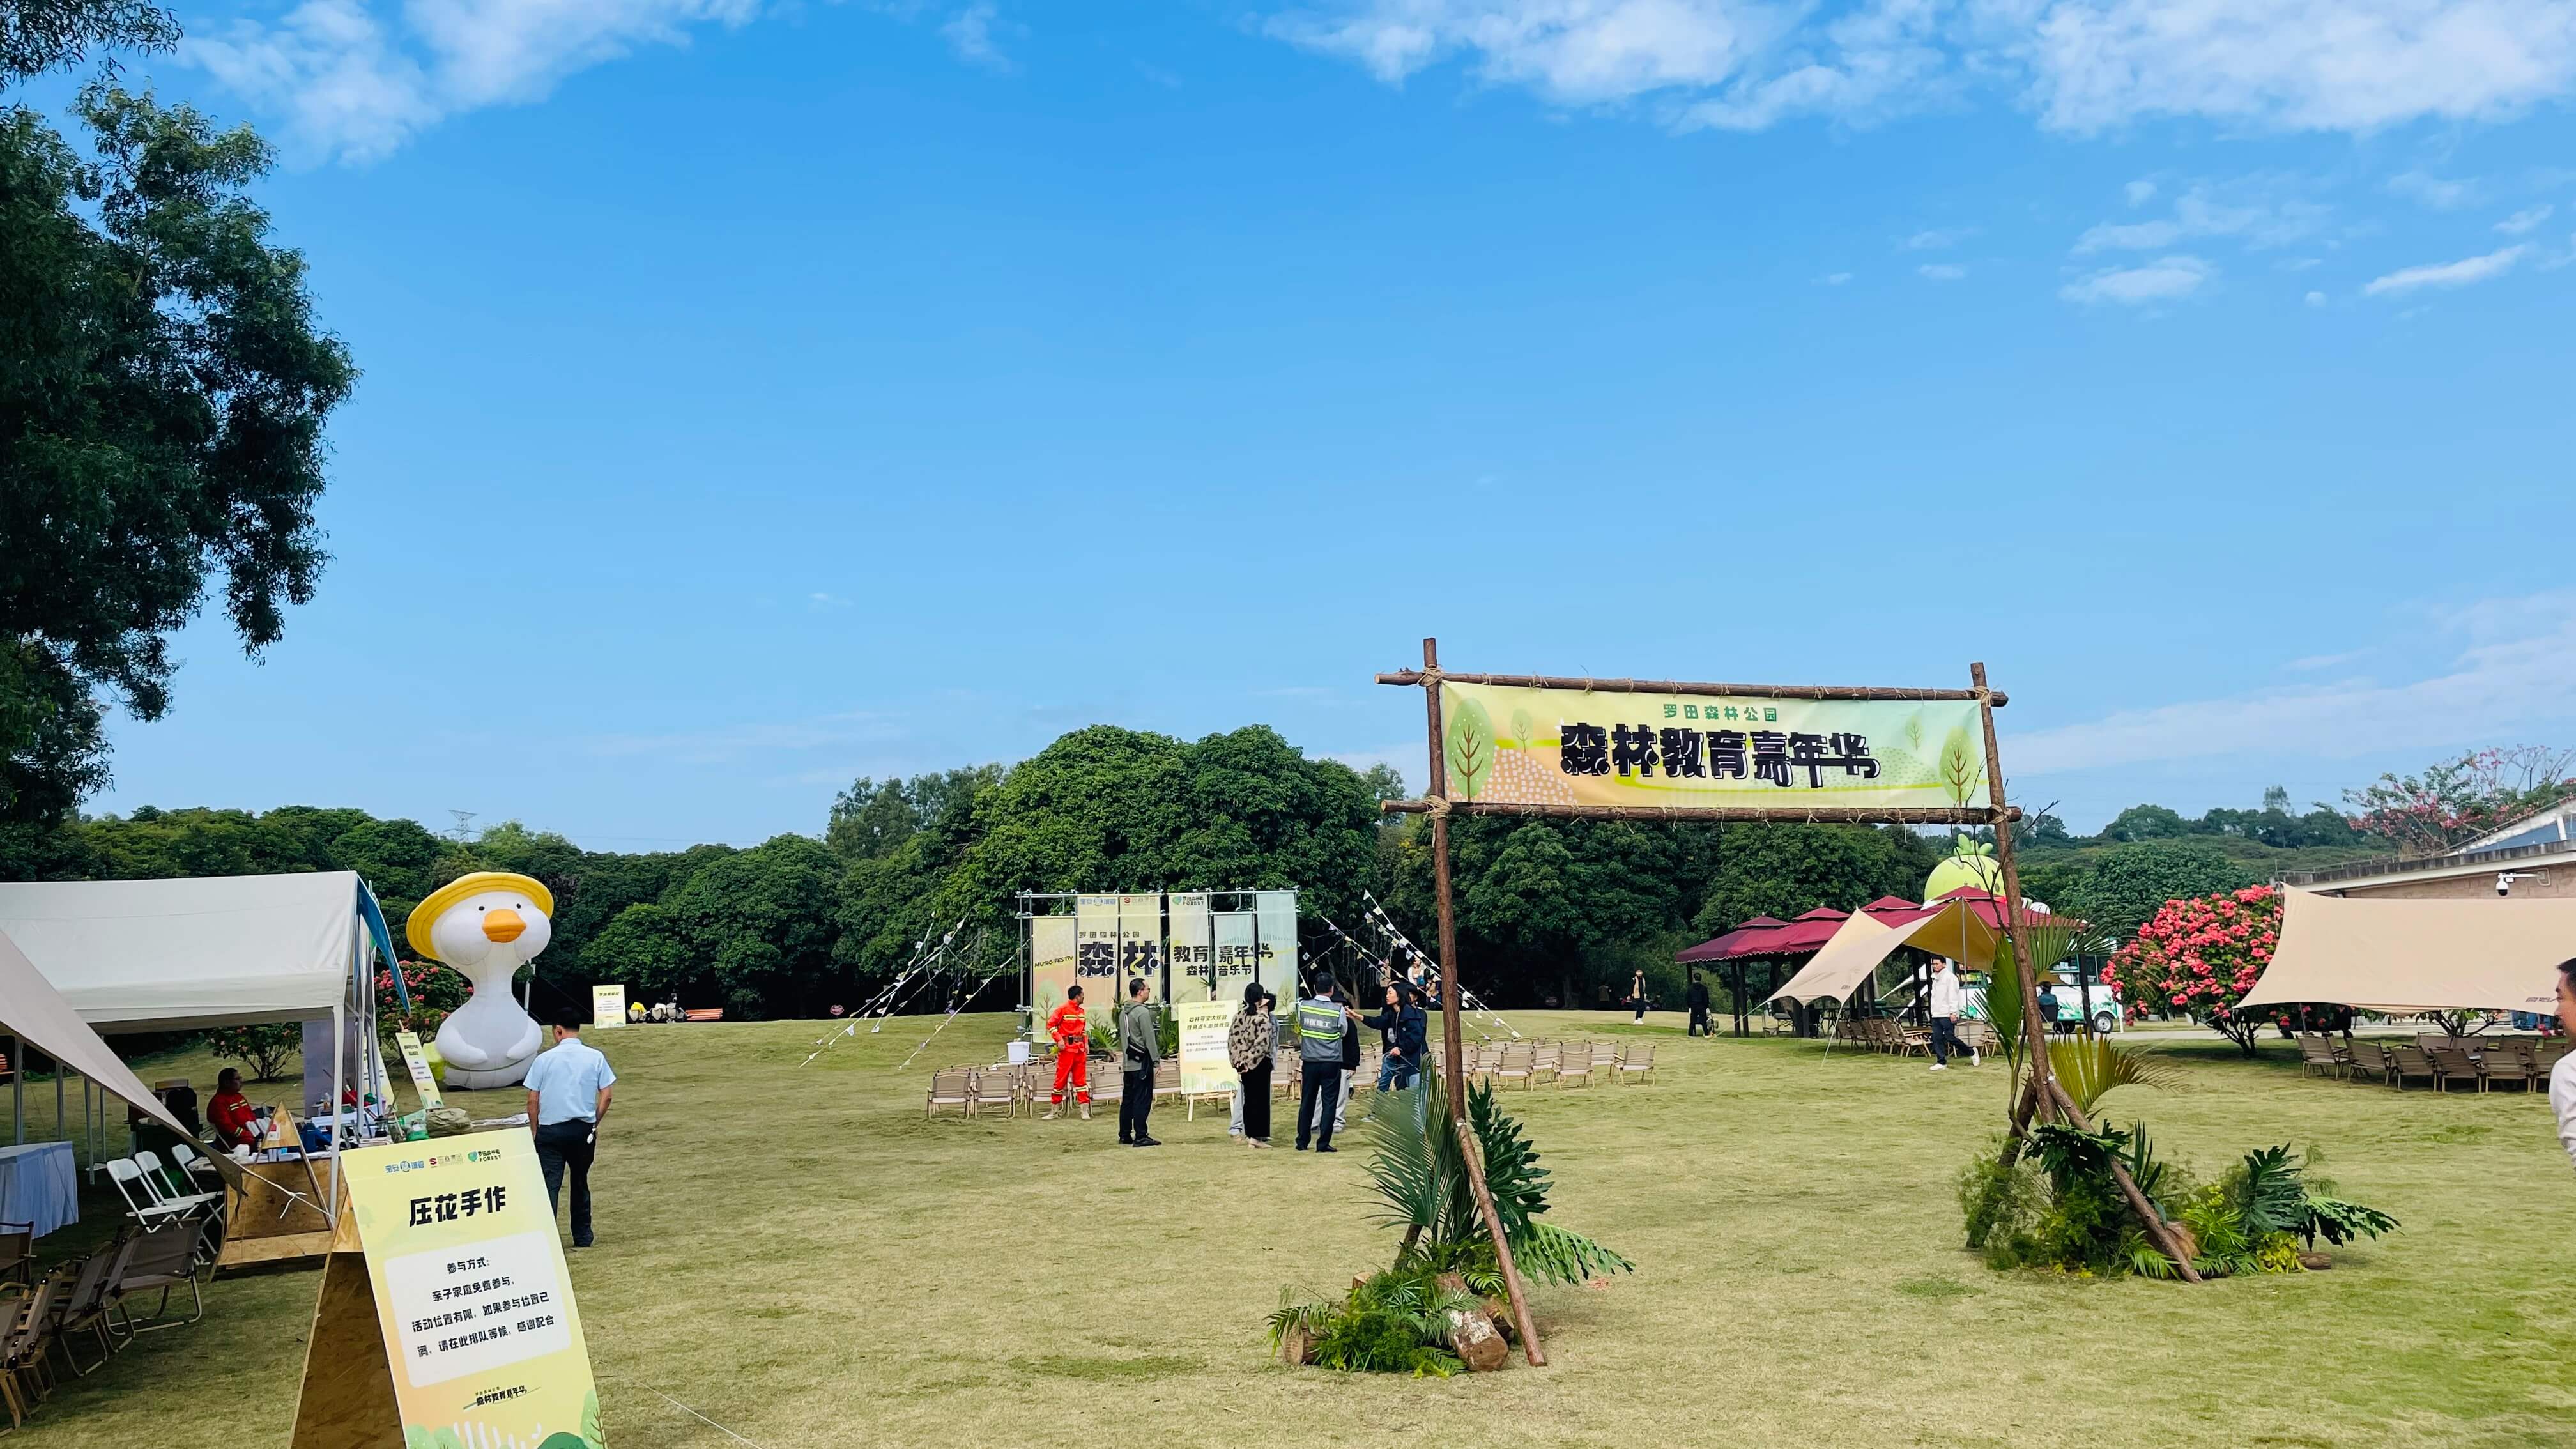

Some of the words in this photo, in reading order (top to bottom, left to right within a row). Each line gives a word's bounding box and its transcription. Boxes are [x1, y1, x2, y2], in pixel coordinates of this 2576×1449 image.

[1663, 703, 1777, 722] 罗田森林公园
[1560, 722, 1882, 788] 森林教育嘉年华
[1078, 940, 1160, 977] 森林
[409, 1185, 506, 1227] 压花手作
